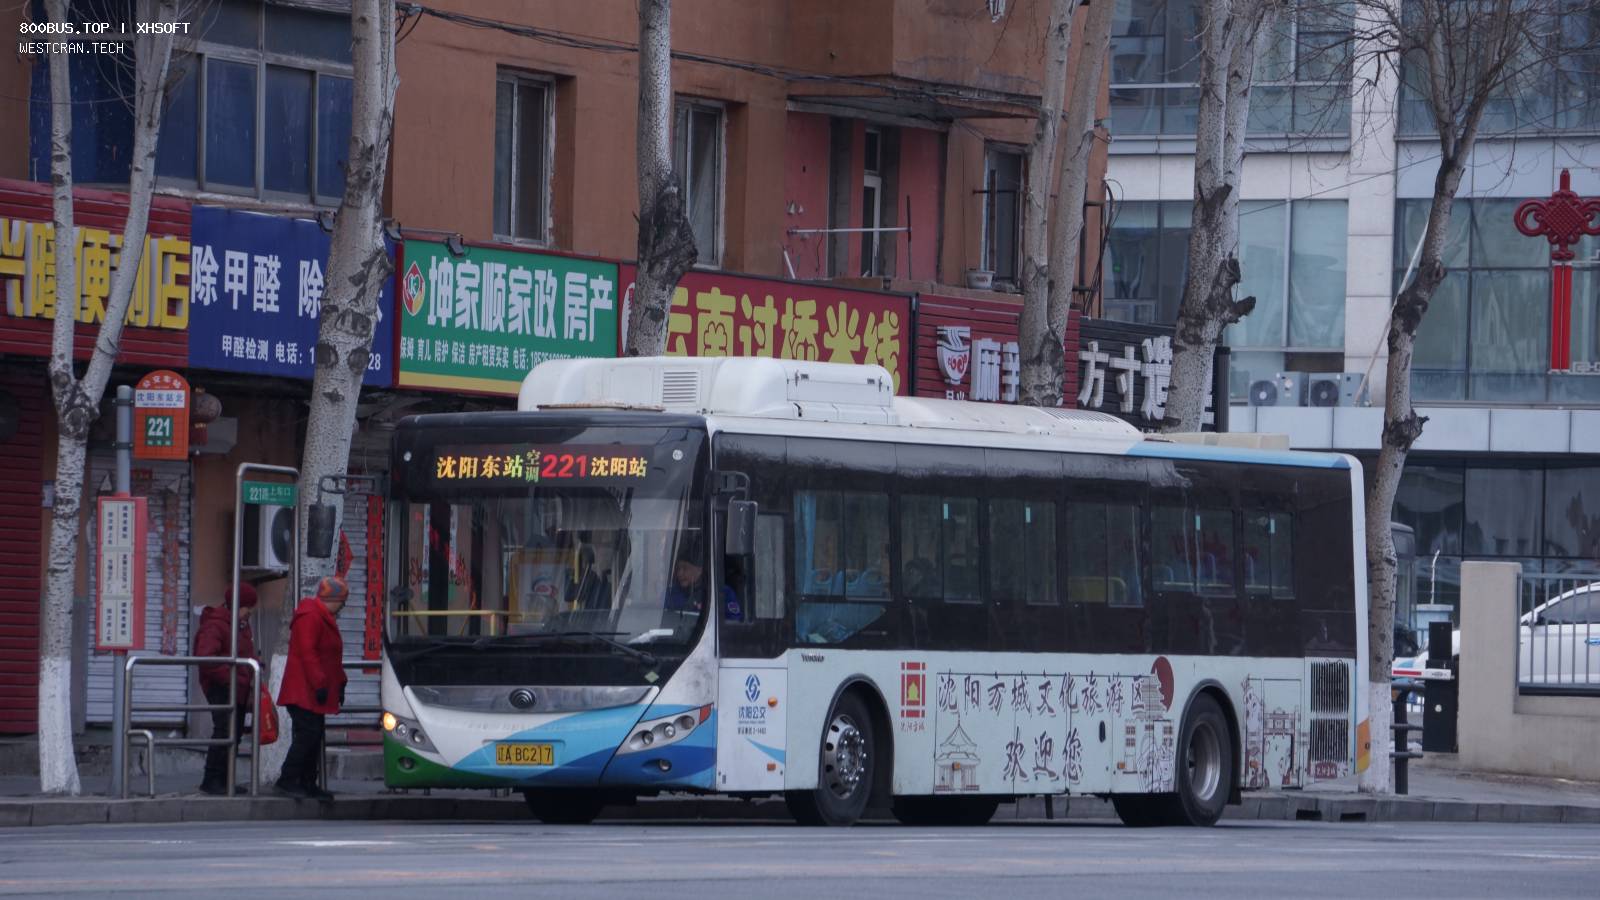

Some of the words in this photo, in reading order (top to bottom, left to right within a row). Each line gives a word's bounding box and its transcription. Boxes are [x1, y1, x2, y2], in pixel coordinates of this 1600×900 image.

[190, 244, 281, 313] 除甲醛
[427, 255, 557, 339] 坤家顺家政
[563, 271, 613, 343] 房产
[222, 334, 269, 362] 甲醛检测
[399, 335, 414, 360] 保姆
[418, 338, 431, 361] 育儿
[435, 339, 449, 363] 陪护
[451, 340, 465, 365] 保洁
[468, 341, 509, 369] 房产租赁买卖
[665, 286, 901, 395] 云南过桥米线
[147, 417, 171, 437] 221
[436, 454, 523, 480] 沈阳东站
[525, 448, 541, 483] 空调
[541, 454, 588, 479] 221
[590, 456, 648, 478] 沈阳站
[937, 668, 1145, 717] 沈阳方城文化旅游区
[1003, 726, 1083, 784] 欢迎您
